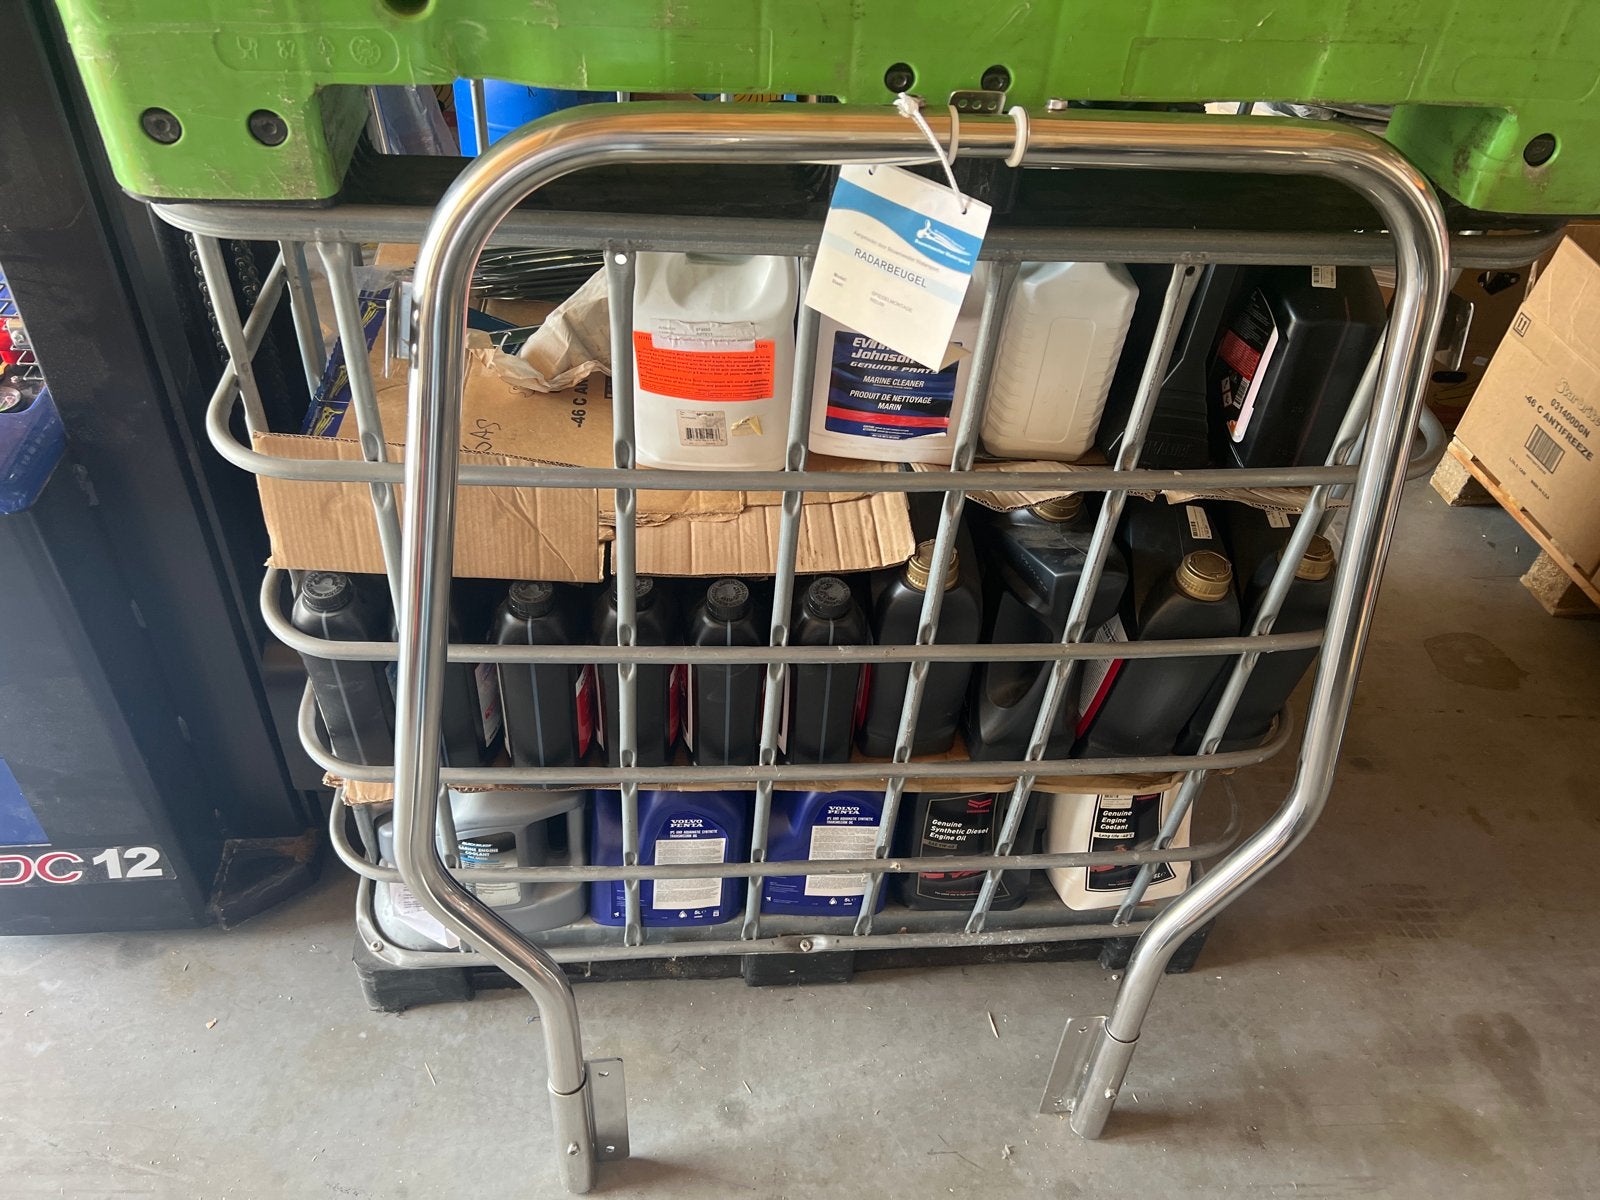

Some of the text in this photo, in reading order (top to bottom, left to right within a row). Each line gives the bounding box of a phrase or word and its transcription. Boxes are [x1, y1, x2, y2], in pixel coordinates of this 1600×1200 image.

[854, 248, 927, 288] RADARBEUGEL
[850, 361, 898, 372] GENUINE
[863, 375, 891, 385] MARINE
[892, 378, 925, 388] CLEANER
[573, 397, 587, 406] C
[849, 389, 880, 400] PRODUIT
[892, 395, 932, 404] NETTOYAGE
[877, 402, 902, 411] MARIN
[571, 409, 586, 428] -46
[1551, 398, 1591, 439] 031400DGN
[1524, 395, 1594, 462] -46 C ANTIFREEZE
[931, 819, 963, 828] Genuine
[1101, 817, 1127, 825] Engine
[930, 825, 989, 835] Synthetic Diesel
[929, 832, 955, 841] Engine
[92, 846, 163, 880] 12
